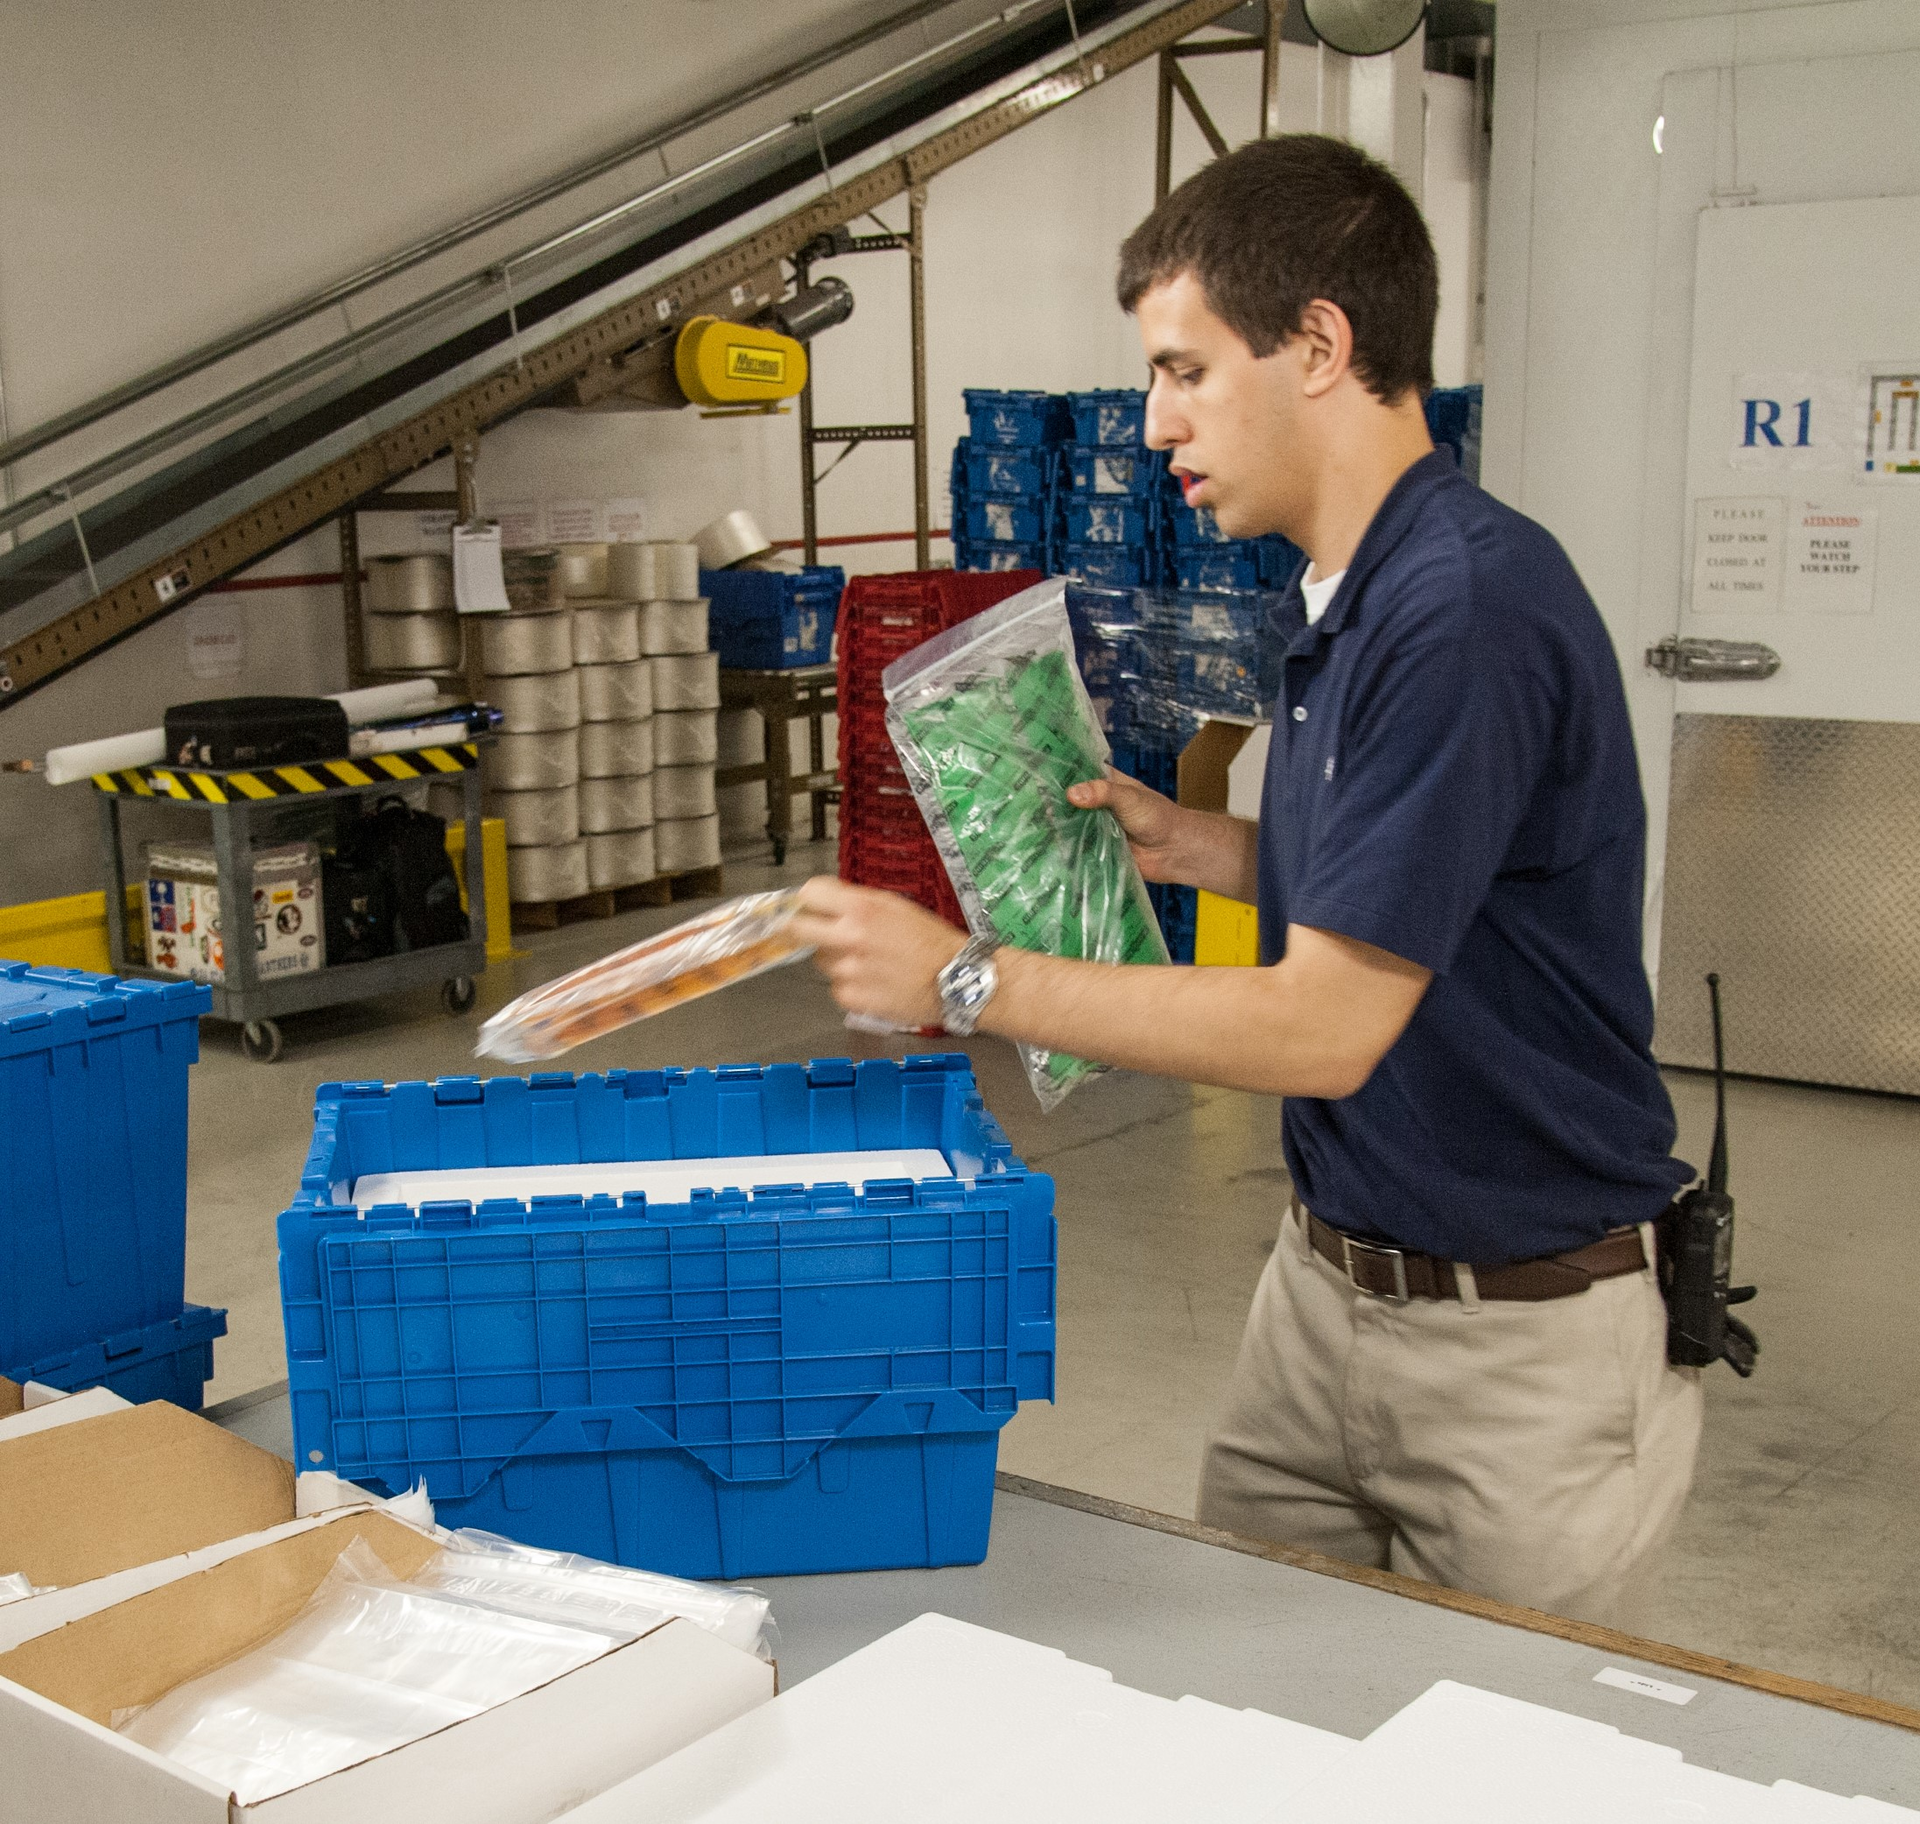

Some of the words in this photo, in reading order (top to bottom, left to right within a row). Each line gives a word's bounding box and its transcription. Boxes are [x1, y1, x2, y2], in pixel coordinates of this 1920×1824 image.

[1739, 397, 1812, 448] R1
[1713, 509, 1765, 519] PLEASE
[1803, 516, 1860, 527] ATTENTION
[1708, 534, 1735, 543] KEEP
[1738, 533, 1768, 543] DOOR
[1810, 540, 1850, 549] PLEASE
[1810, 552, 1851, 561] WATCH
[1707, 557, 1749, 567] CLOSED
[1753, 557, 1766, 567] AT
[1801, 564, 1831, 573] YOUR
[1833, 564, 1860, 573] STEP
[1709, 581, 1726, 591] ALL
[1733, 581, 1764, 591] TIMES
